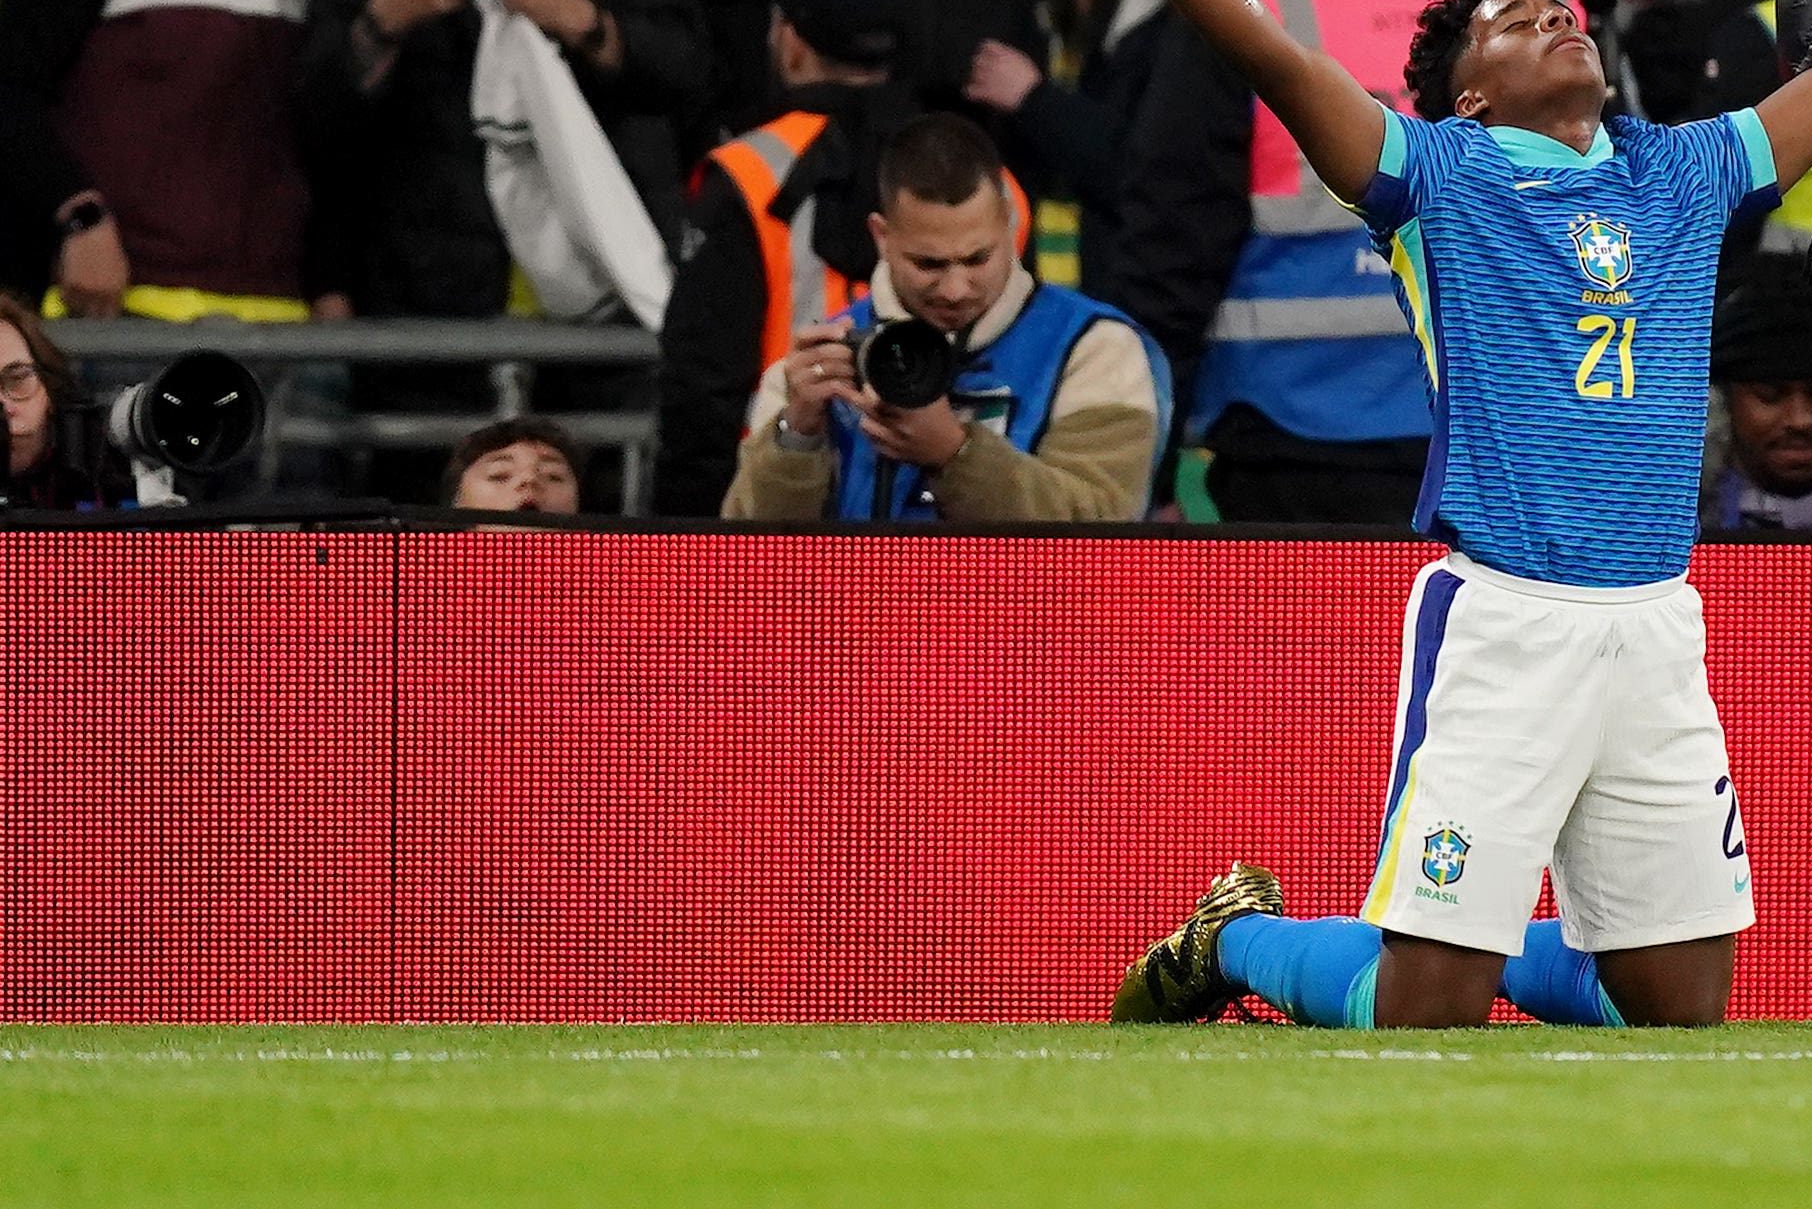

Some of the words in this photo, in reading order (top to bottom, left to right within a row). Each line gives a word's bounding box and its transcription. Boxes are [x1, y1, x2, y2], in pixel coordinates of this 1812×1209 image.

[1594, 246, 1614, 256] CBF
[1582, 289, 1634, 305] BRASIL
[1576, 314, 1637, 399] 21
[1414, 885, 1460, 905] BRASIL
